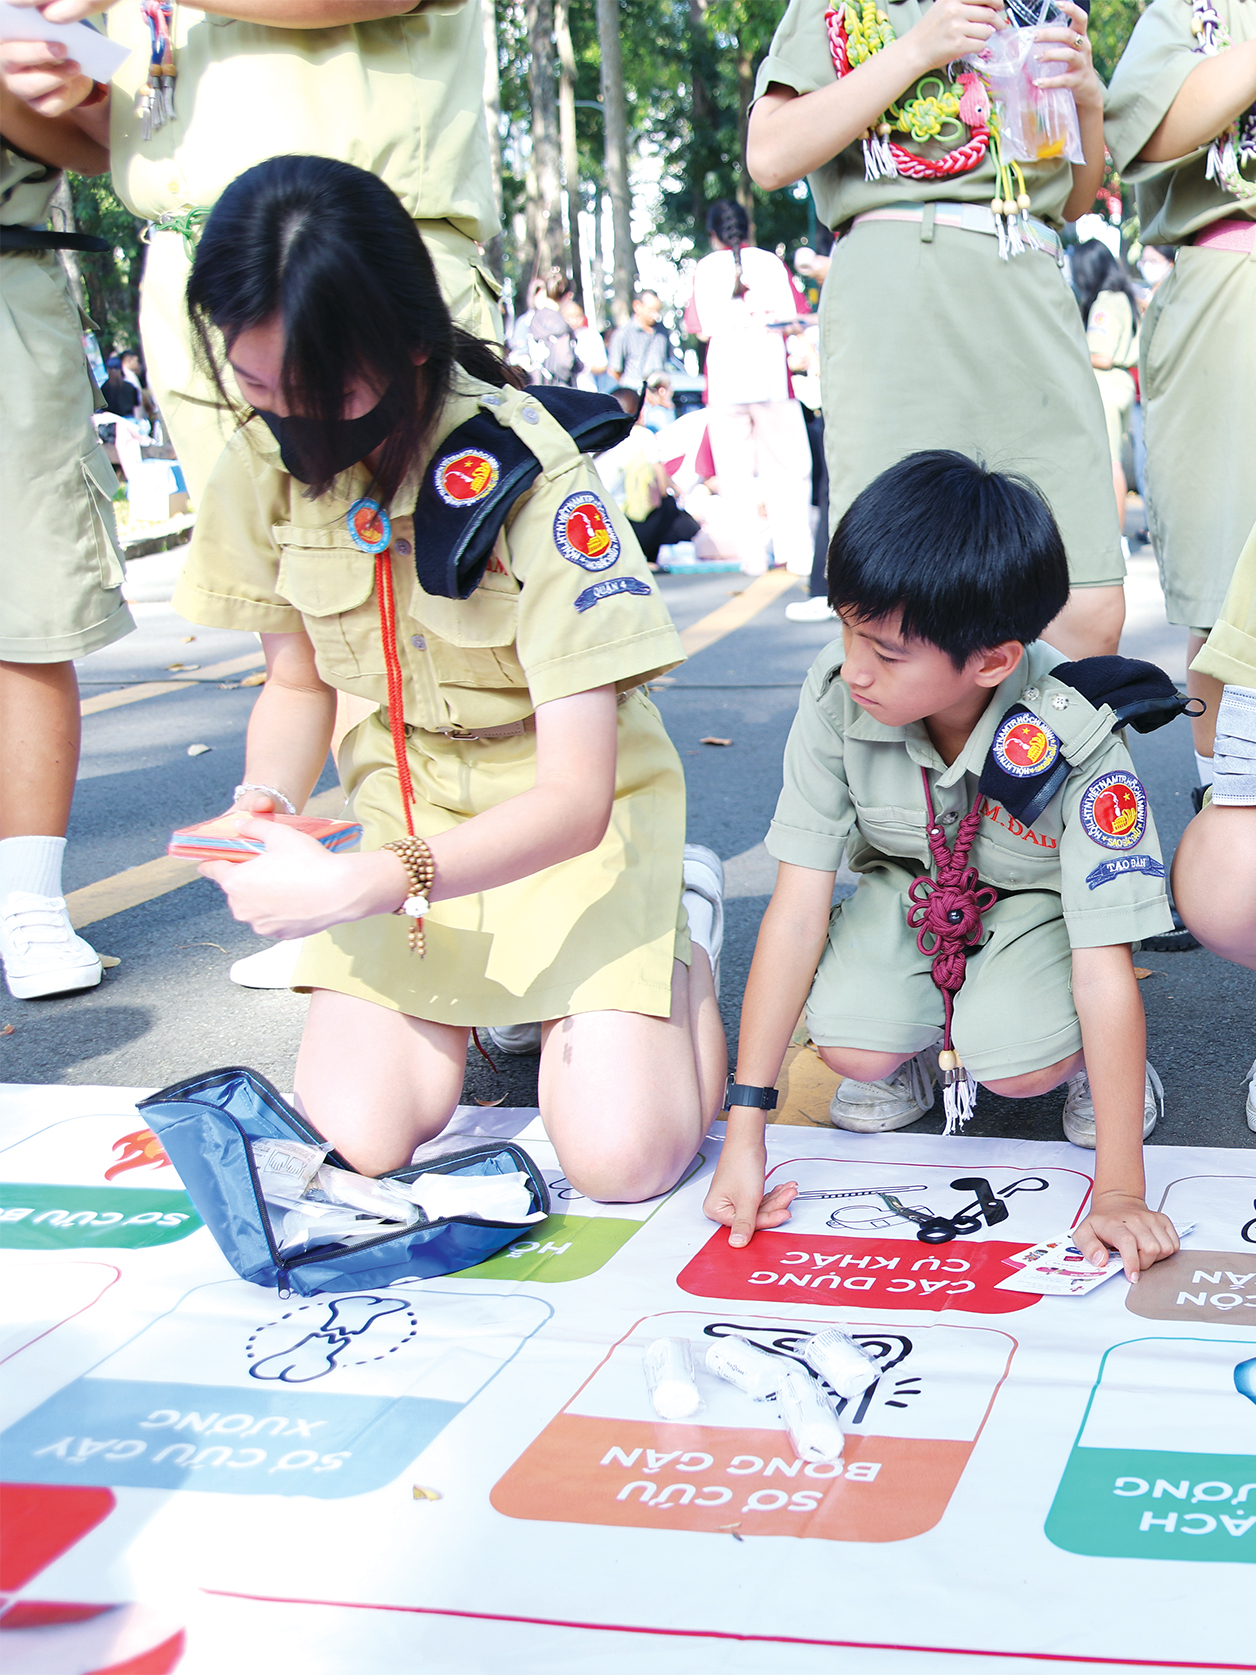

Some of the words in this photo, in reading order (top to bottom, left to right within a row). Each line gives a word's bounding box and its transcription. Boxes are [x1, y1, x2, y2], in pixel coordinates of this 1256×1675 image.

[619, 580, 627, 589] 4
[1106, 860, 1130, 873] TAO
[32, 1209, 124, 1228] CỨU
[121, 1211, 190, 1227] SƠ
[505, 1241, 574, 1259] HỖ
[779, 1251, 902, 1270] KHÁC
[911, 1255, 971, 1273] CỤ
[748, 1271, 877, 1291] DỤNG
[886, 1278, 976, 1296] CÁC
[139, 1409, 328, 1438] XƯƠNG
[151, 1442, 267, 1470] CỨU
[267, 1449, 353, 1474] SƠ
[600, 1445, 714, 1474] GÂN
[726, 1454, 882, 1483] BONG
[616, 1480, 733, 1509] CỨU
[741, 1490, 824, 1513] SƠ
